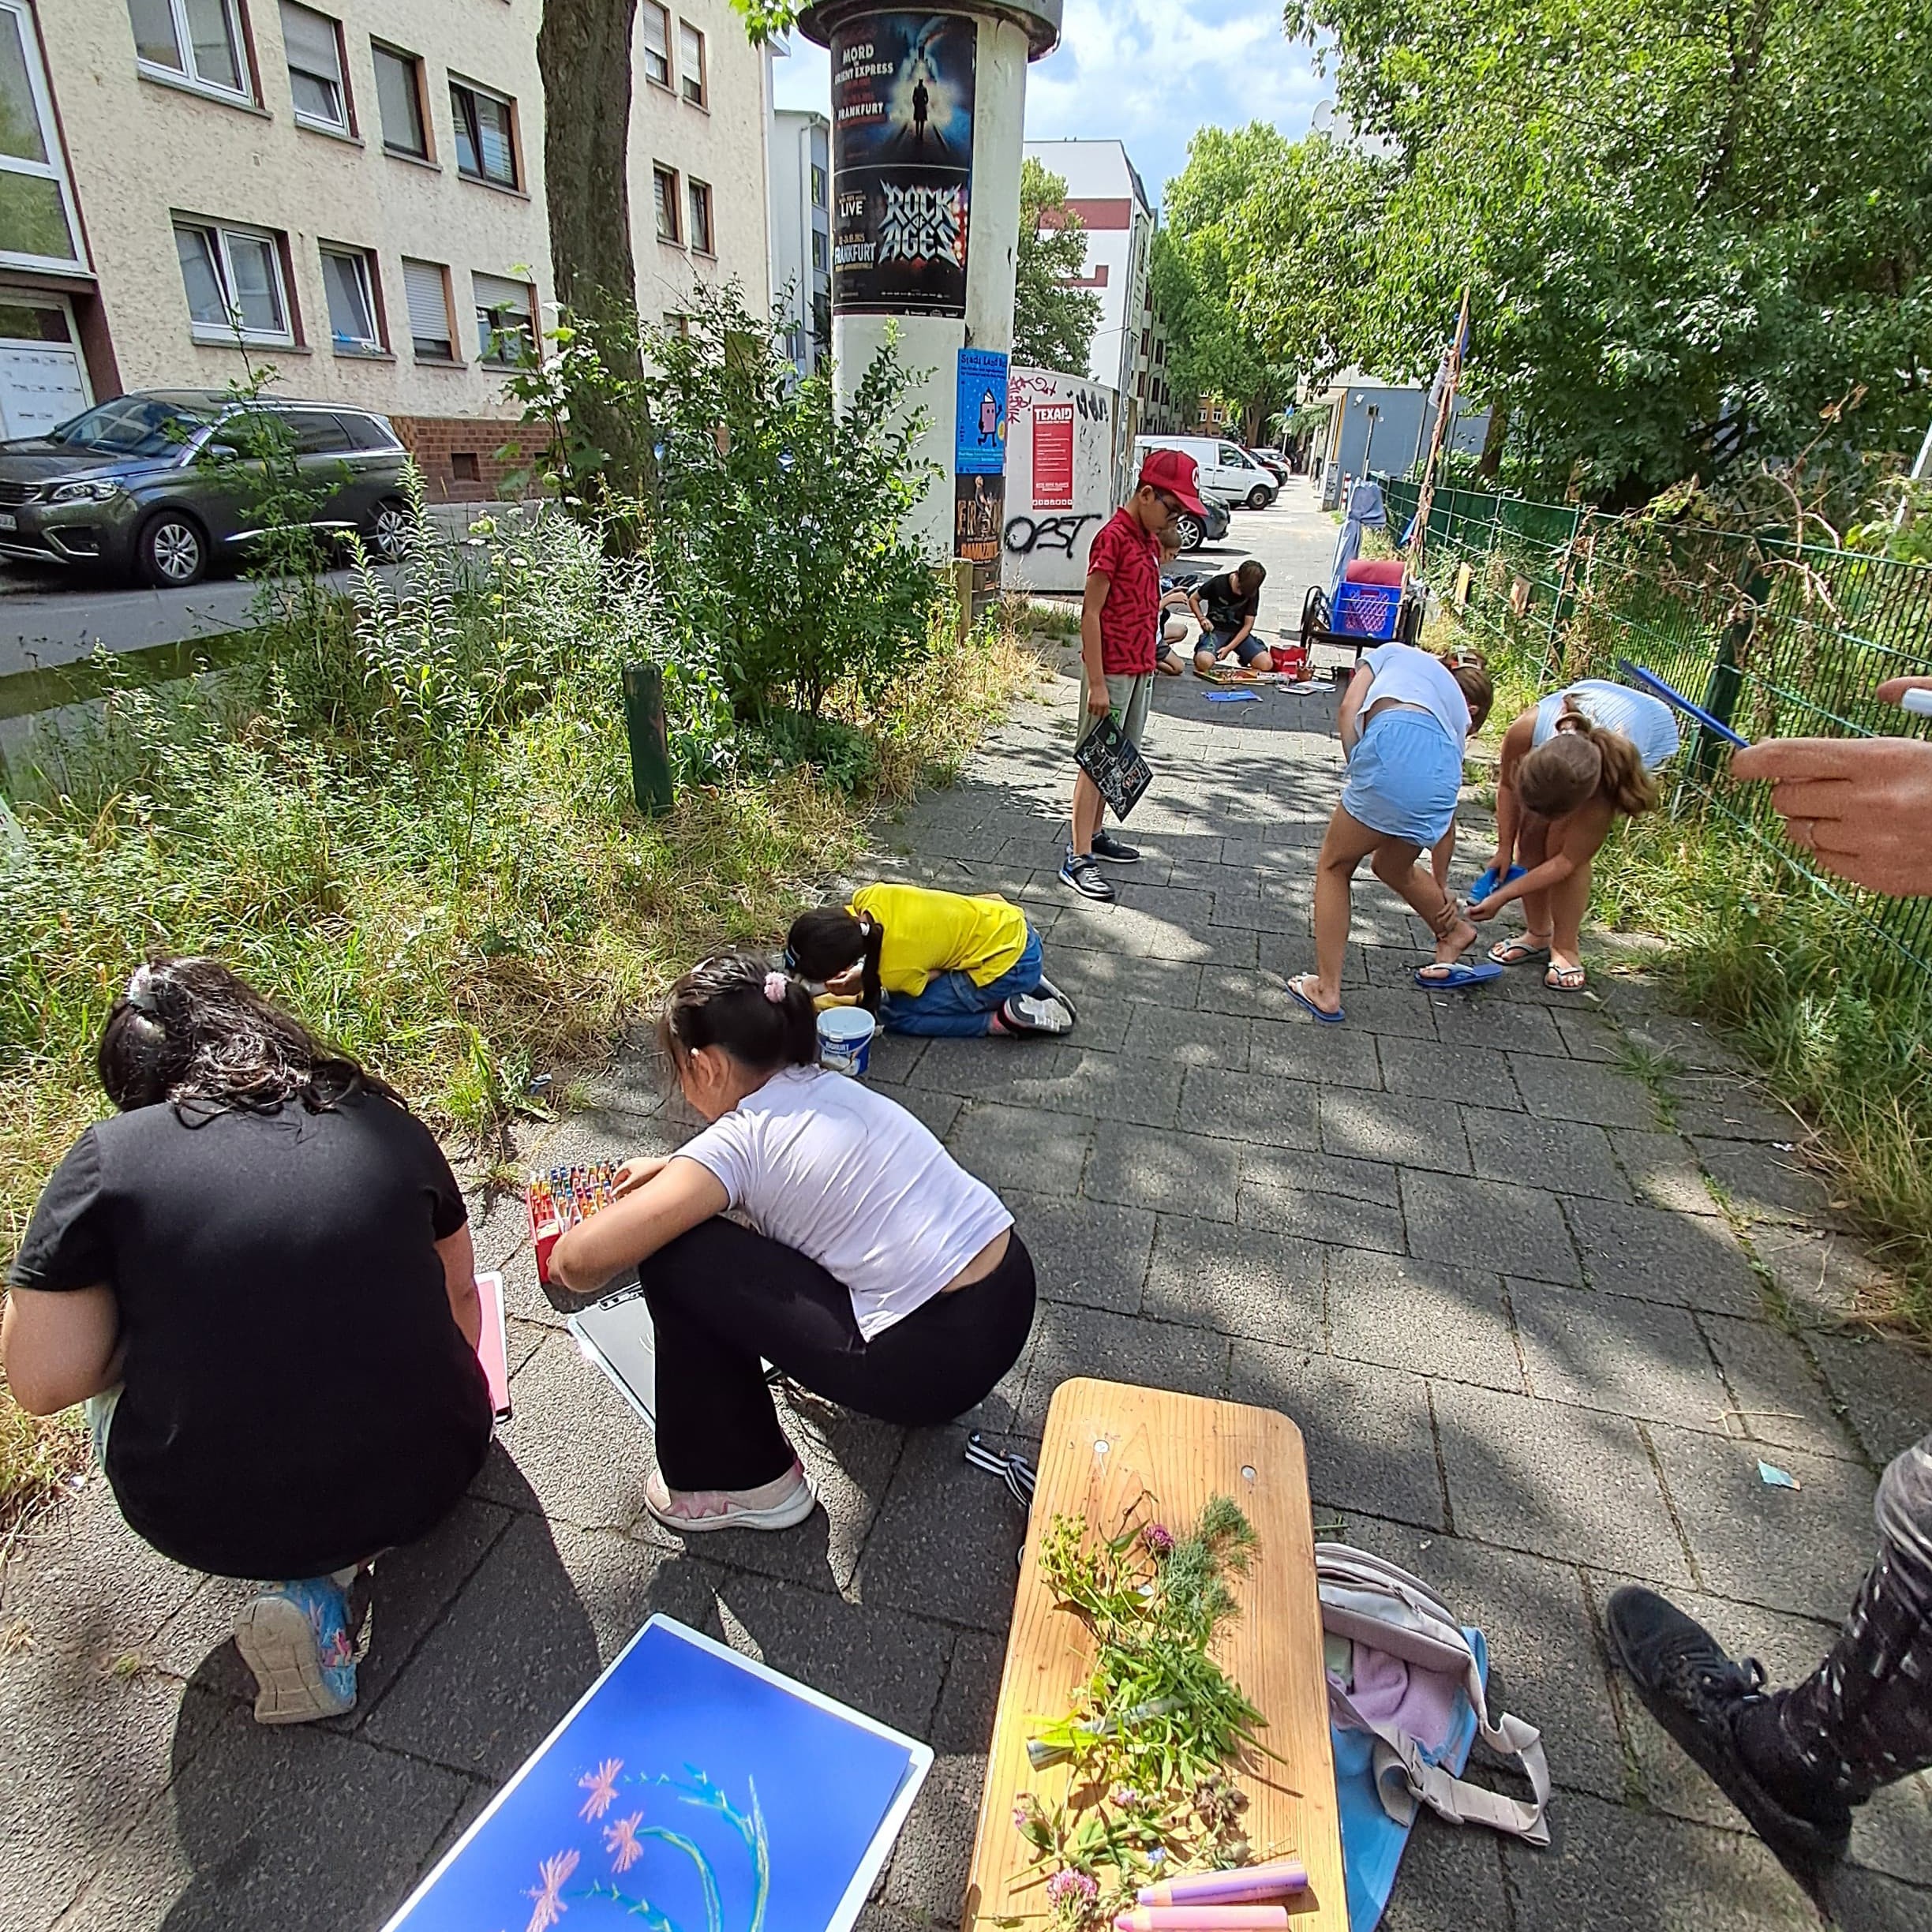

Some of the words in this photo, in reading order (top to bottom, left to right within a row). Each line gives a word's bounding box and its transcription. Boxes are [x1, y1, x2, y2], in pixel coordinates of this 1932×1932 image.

[842, 43, 874, 66] MORD
[855, 62, 893, 79] EXPRESS
[841, 200, 863, 218] LIVE
[878, 178, 962, 232] ROCK
[912, 215, 925, 228] OF
[878, 221, 964, 270] AGES
[1034, 407, 1073, 421] TEXAID
